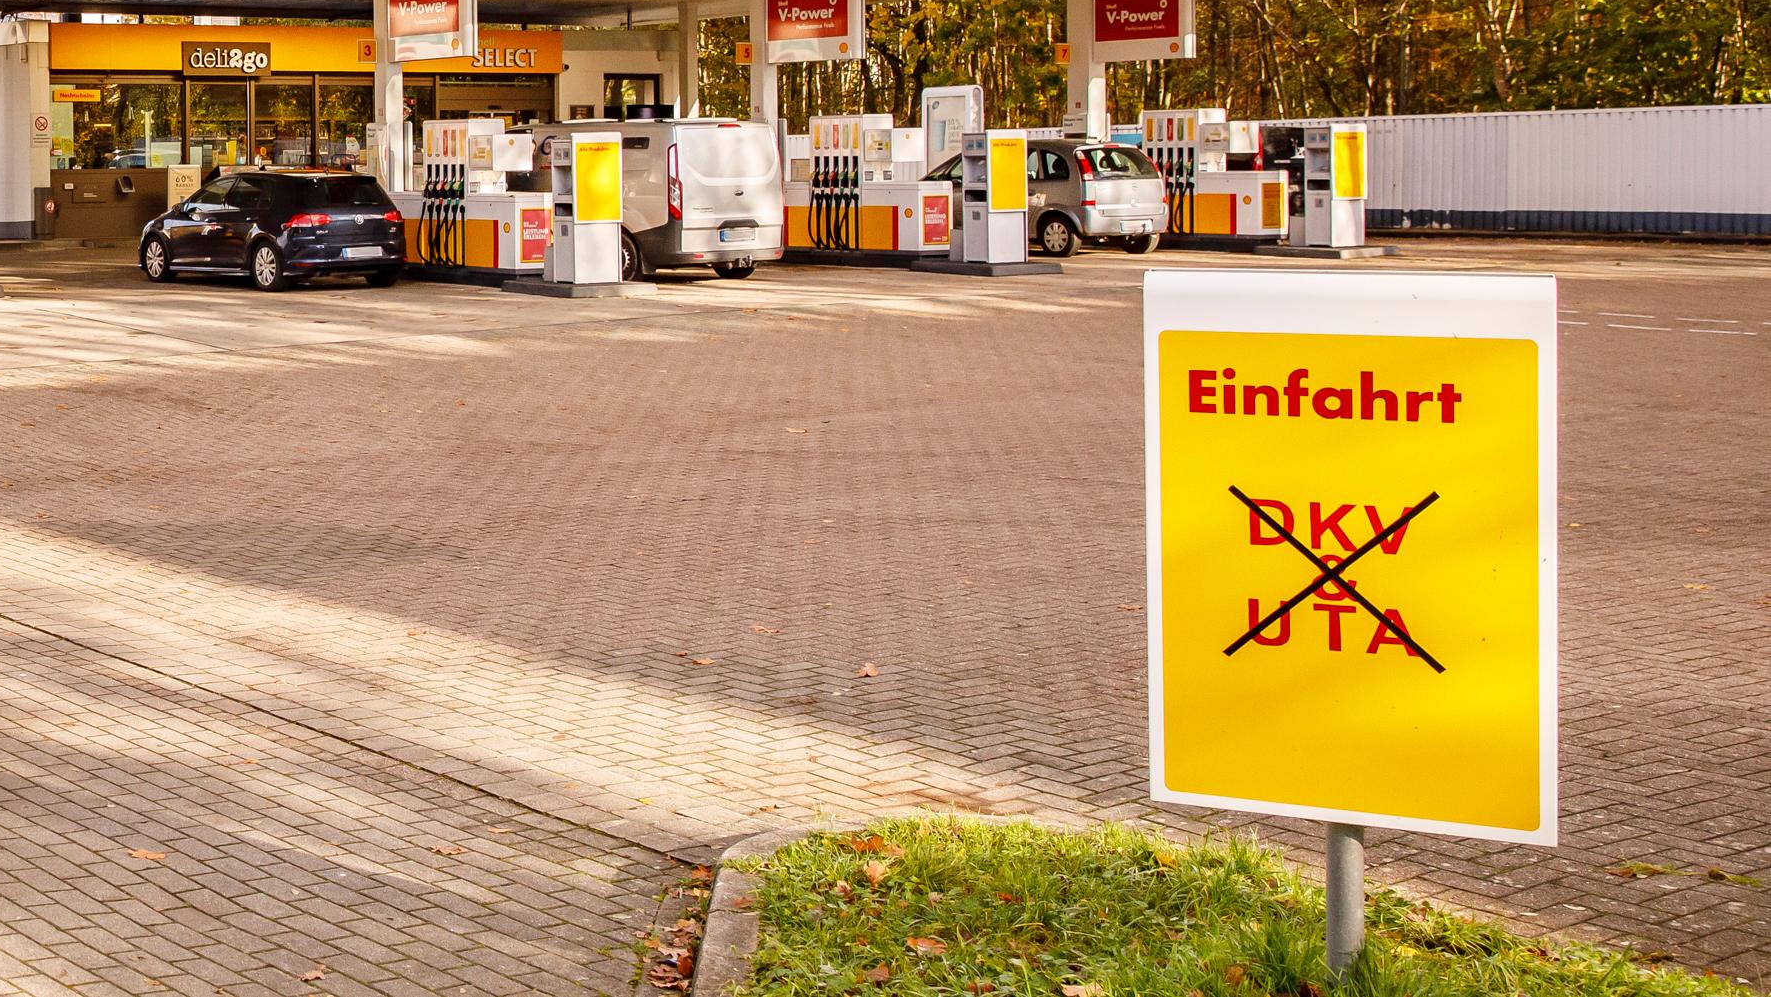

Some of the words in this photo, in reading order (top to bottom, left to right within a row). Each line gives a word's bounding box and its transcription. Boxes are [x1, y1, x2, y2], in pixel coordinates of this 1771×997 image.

[398, 0, 448, 17] V-Power
[778, 7, 835, 22] V-Power
[1106, 10, 1165, 24] V-Power
[364, 45, 372, 56] 3
[474, 48, 537, 67] SELECT
[744, 48, 750, 58] 5
[1061, 49, 1068, 59] 7
[190, 47, 268, 73] deli2go
[1188, 367, 1462, 424] Einfahrt
[1247, 498, 1414, 555] DKV
[1311, 554, 1358, 602] &
[1247, 598, 1421, 657] UTA
